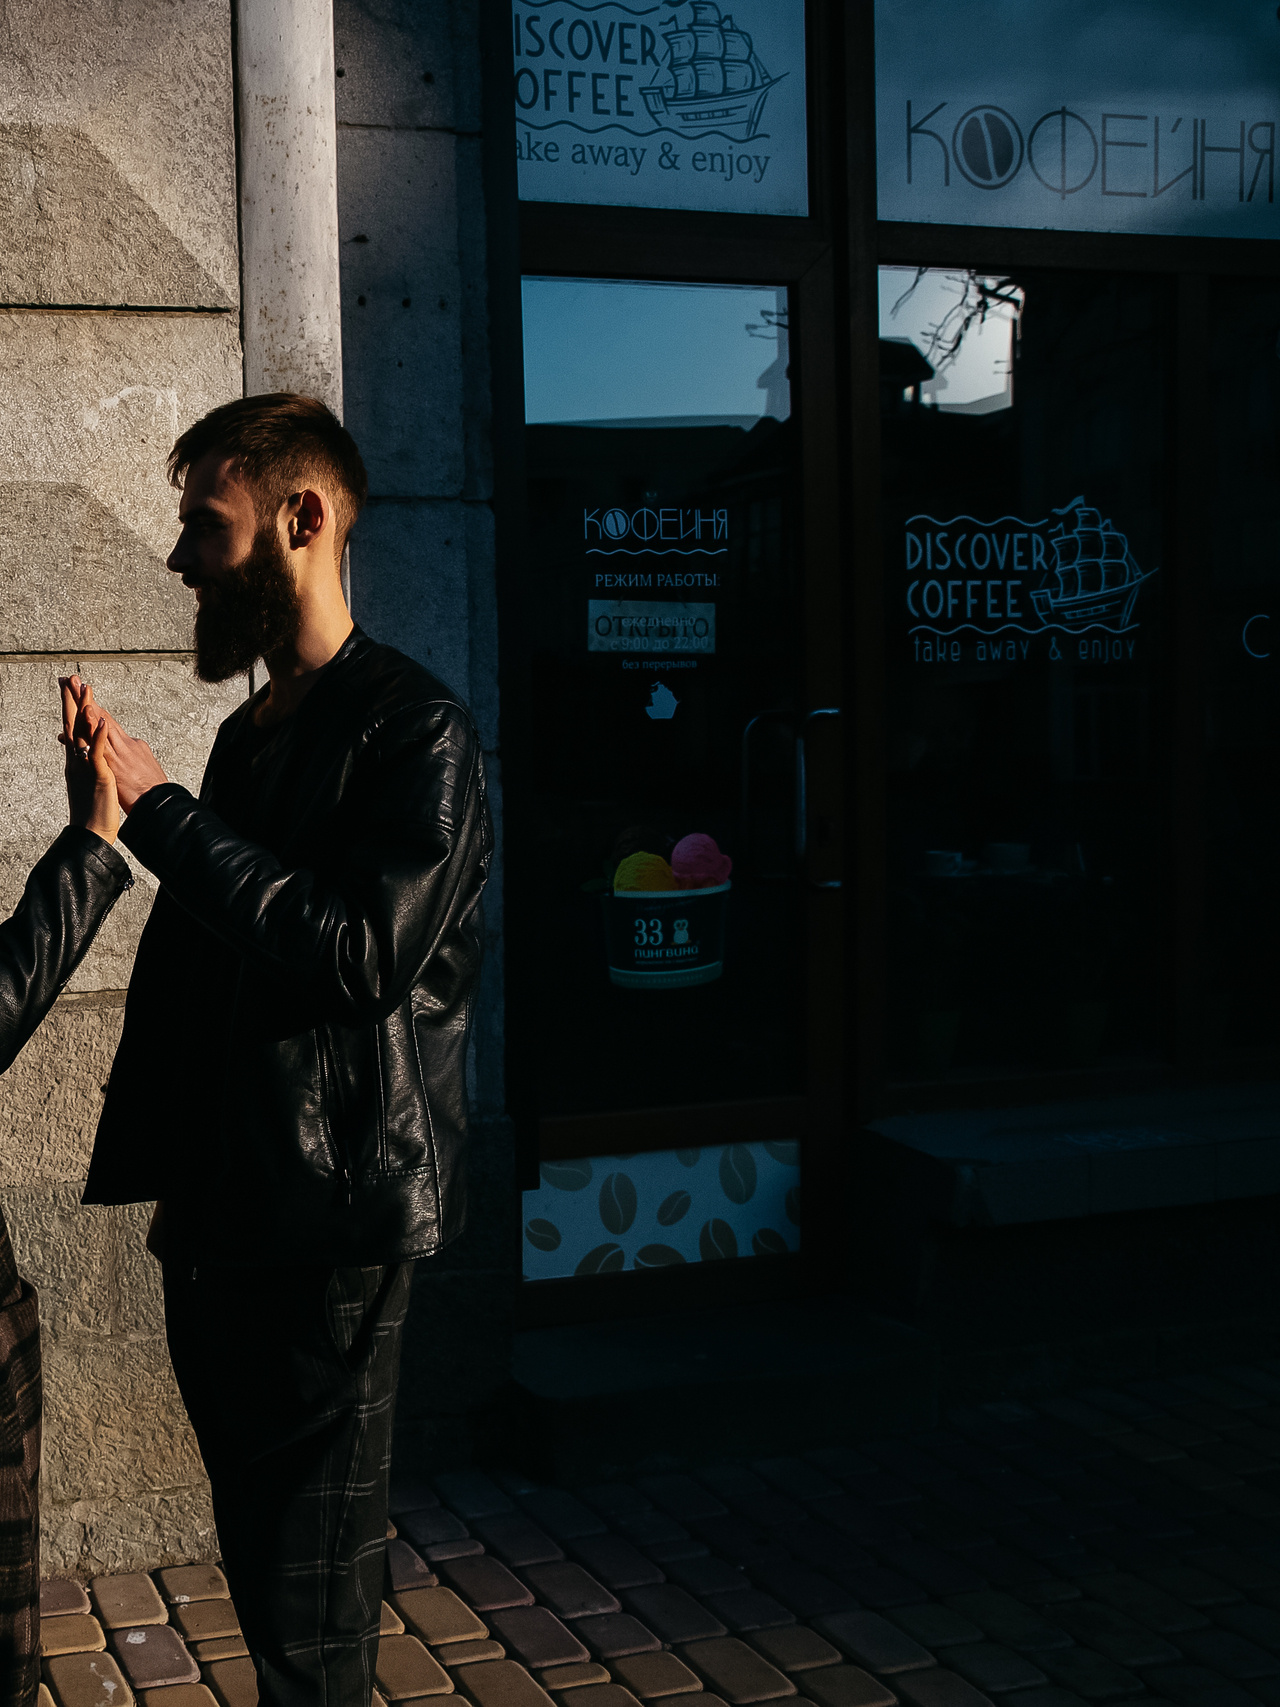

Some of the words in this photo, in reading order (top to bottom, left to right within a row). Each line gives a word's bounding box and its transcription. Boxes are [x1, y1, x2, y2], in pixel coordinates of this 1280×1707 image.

[515, 14, 661, 67] ISCOVER
[513, 67, 635, 117] OFFEE
[516, 132, 560, 163] ake
[571, 141, 647, 176] away
[658, 141, 681, 172] &
[691, 145, 771, 183] enjoy
[906, 100, 1276, 204] КОФЕЙНЯ
[583, 506, 729, 541] КОФЕЙНЯ
[905, 531, 1050, 571] DISCOVER
[594, 573, 652, 588] РЕЖИМ
[906, 579, 1023, 619] COFFEE
[595, 615, 709, 638] ОТКРЫТО
[622, 659, 640, 670] без
[642, 660, 698, 672] перерывов
[913, 635, 962, 663] take
[976, 639, 1030, 661] away
[1048, 636, 1063, 661] &
[1077, 635, 1136, 664] enjoy
[634, 918, 664, 946] 33
